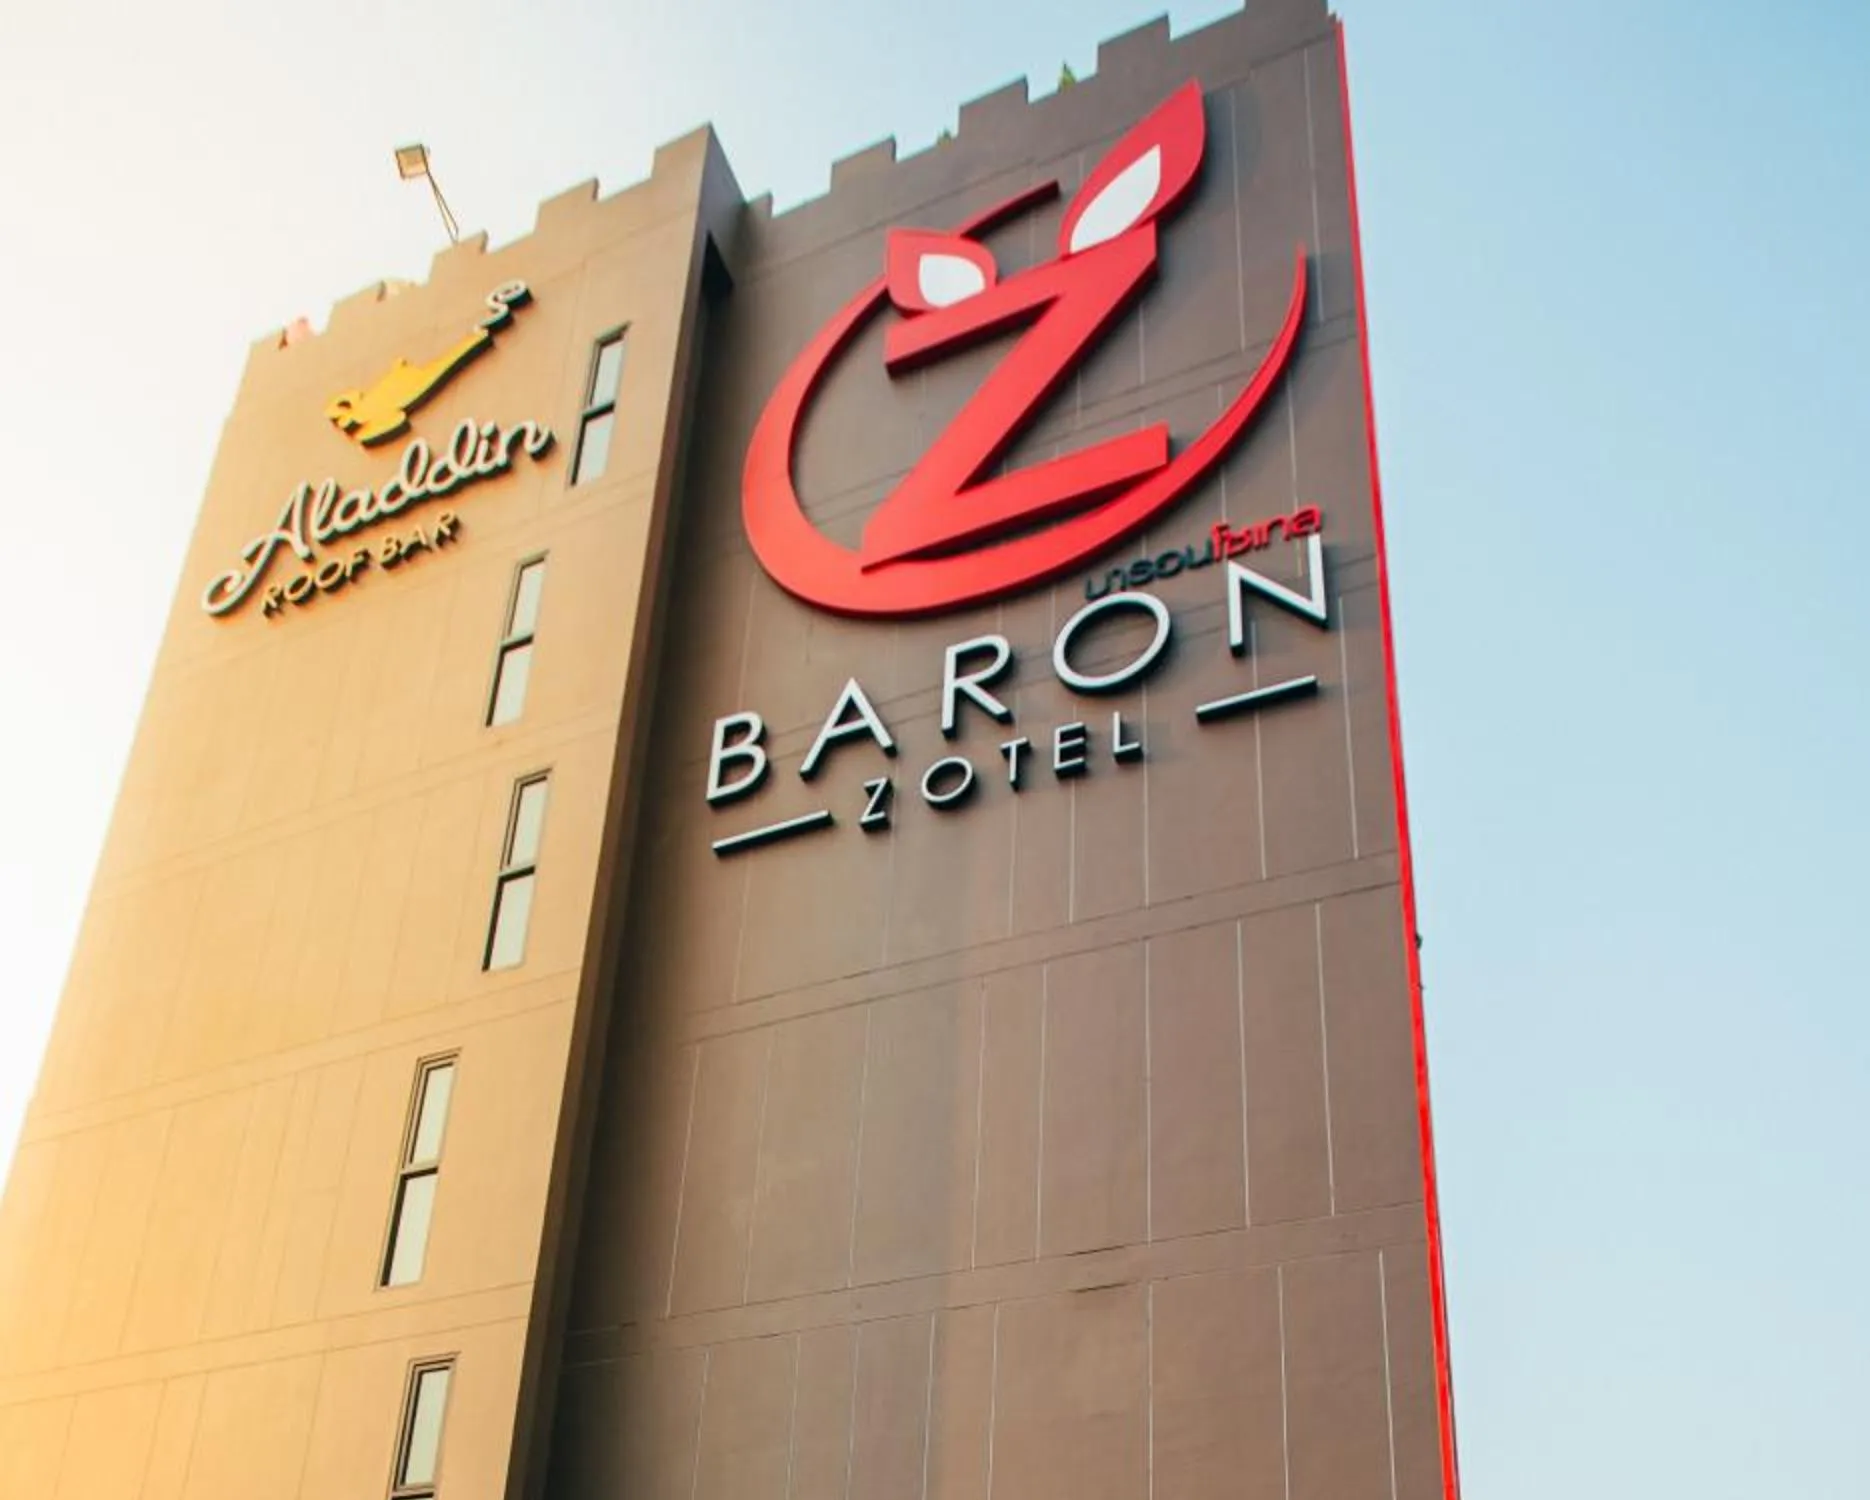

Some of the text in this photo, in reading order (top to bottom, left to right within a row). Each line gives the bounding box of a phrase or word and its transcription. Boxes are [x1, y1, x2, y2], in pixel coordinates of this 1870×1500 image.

[202, 417, 555, 616] Aladdin
[261, 509, 461, 619] ROOF BAR
[1085, 503, 1322, 600] บารอนโซเทล
[706, 533, 1330, 802] BARON
[859, 711, 1144, 831] ZOTEL
